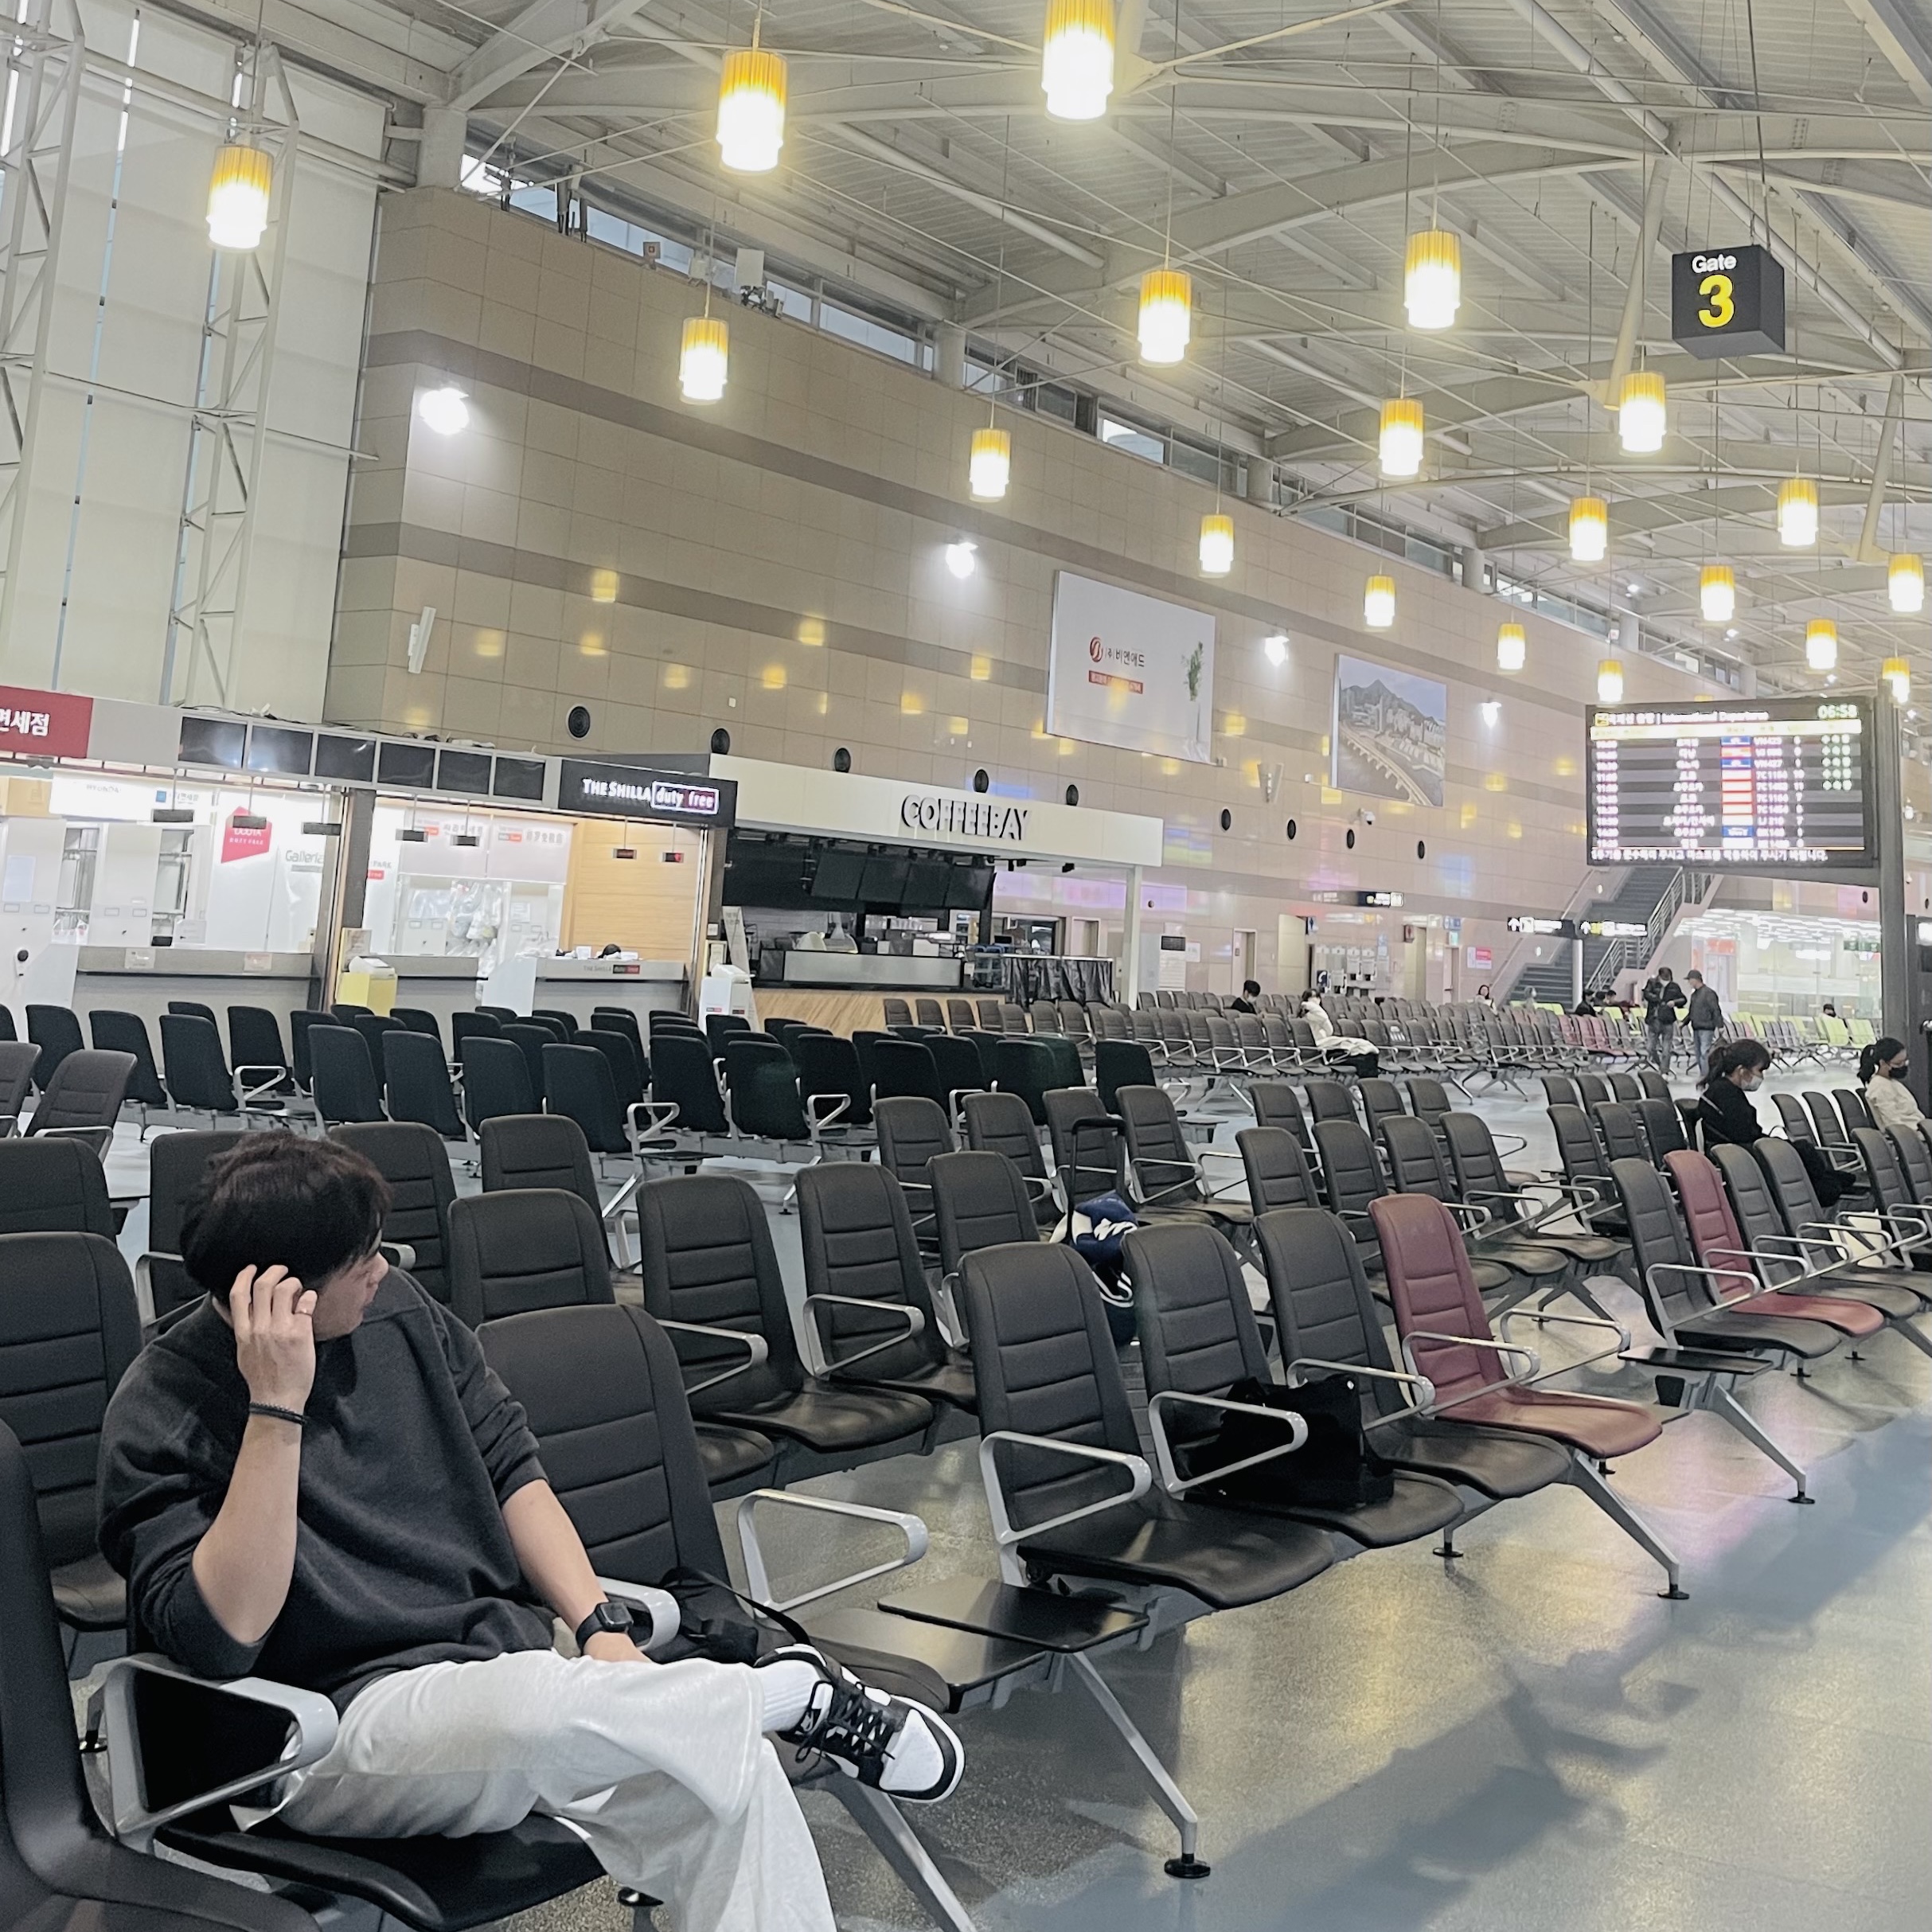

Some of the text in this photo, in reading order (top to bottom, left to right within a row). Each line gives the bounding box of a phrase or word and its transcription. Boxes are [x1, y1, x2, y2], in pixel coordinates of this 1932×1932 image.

[1692, 253, 1737, 274] Gate
[1698, 274, 1735, 328] 3
[583, 779, 714, 807] THE SHILLA duty free
